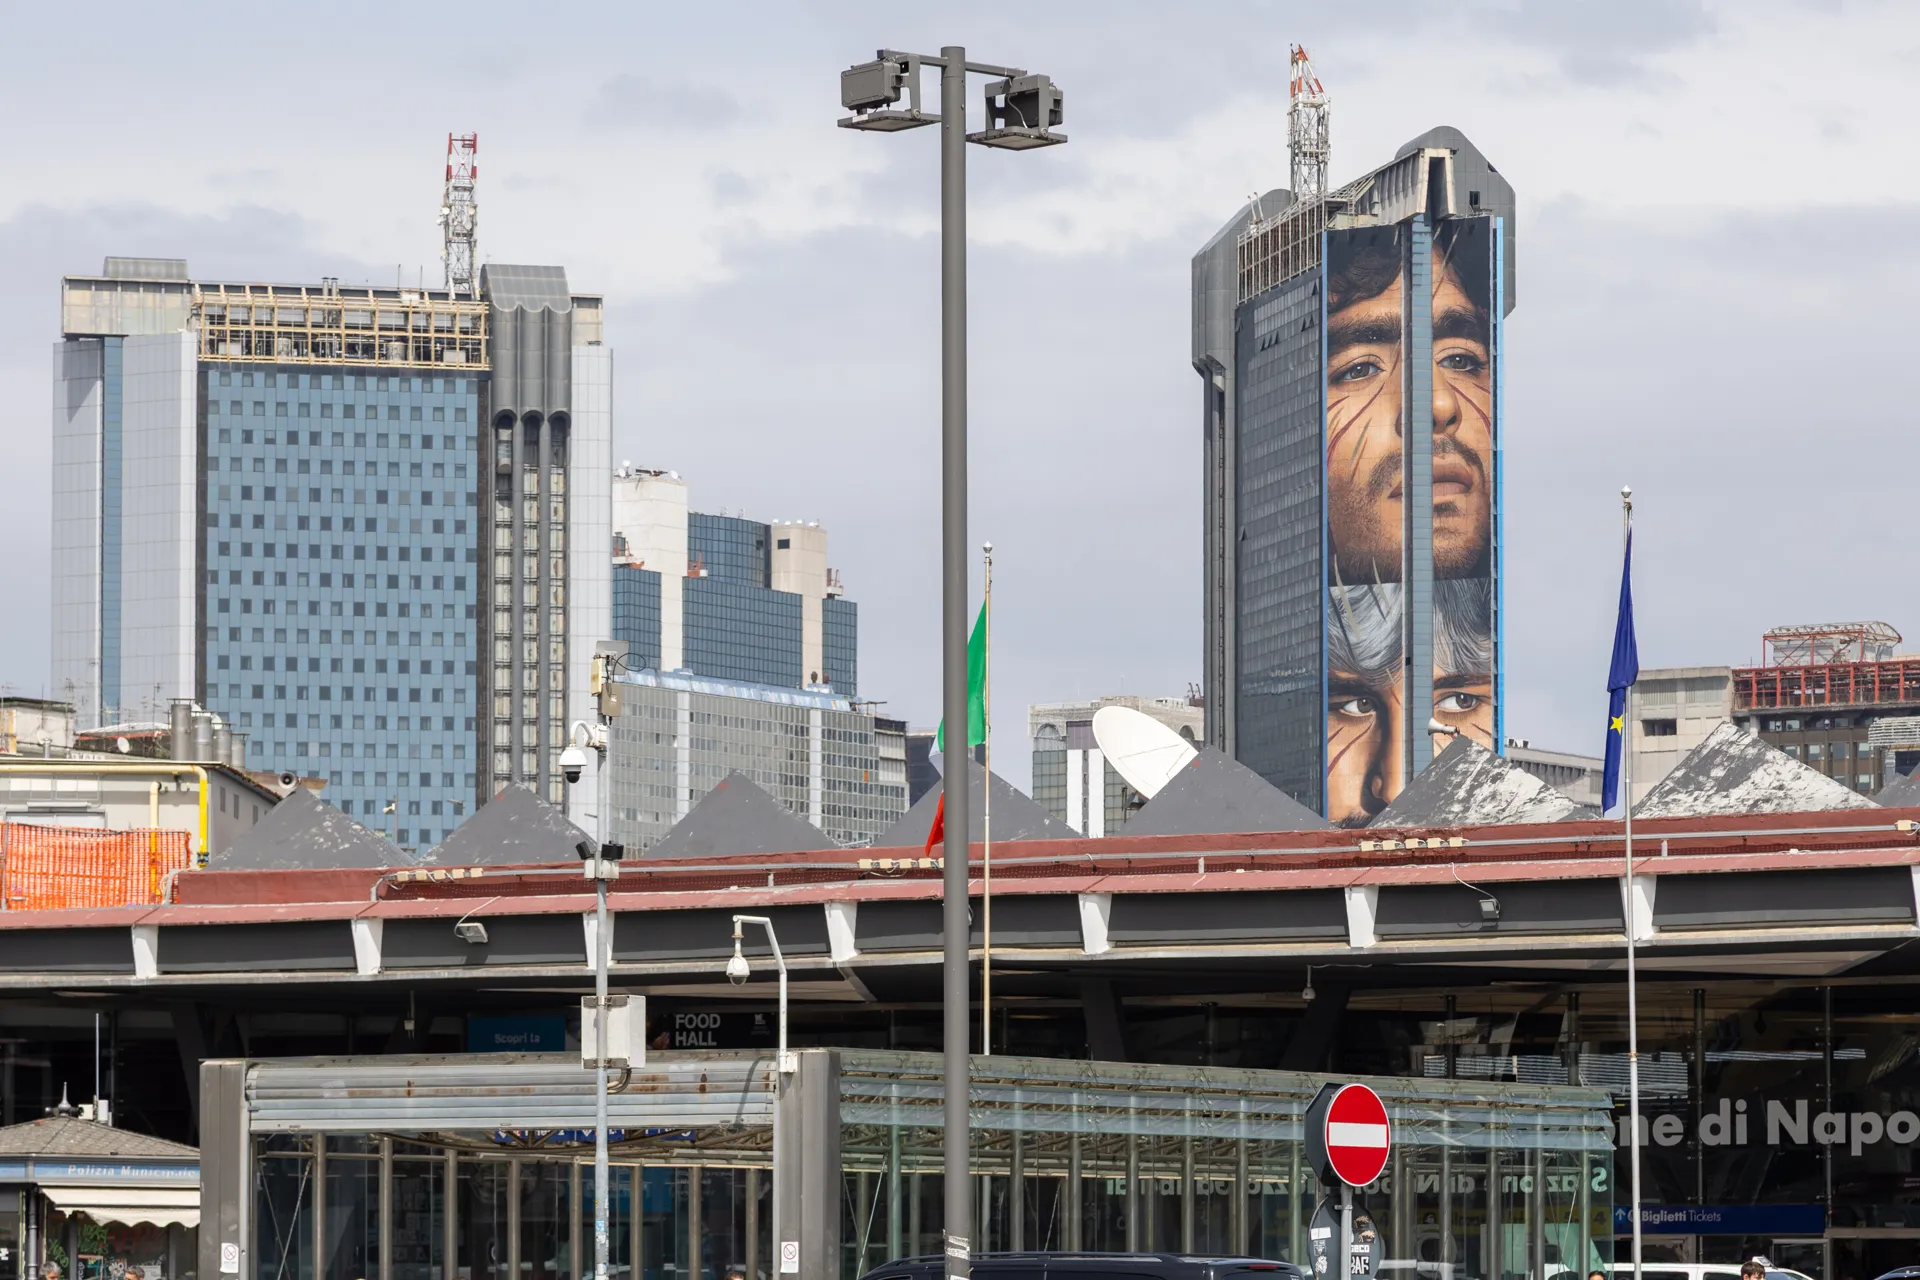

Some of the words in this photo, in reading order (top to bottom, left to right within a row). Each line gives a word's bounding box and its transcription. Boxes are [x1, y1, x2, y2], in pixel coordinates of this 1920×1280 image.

[675, 1013, 721, 1029] FOOD
[494, 1032, 527, 1045] Scopri
[675, 1031, 717, 1046] HALL
[1699, 1098, 1748, 1146] di
[1767, 1099, 1920, 1157] Napo
[68, 1164, 115, 1176] Polizia
[1641, 1209, 1687, 1224] Biglietti
[1688, 1209, 1722, 1222] Tickets
